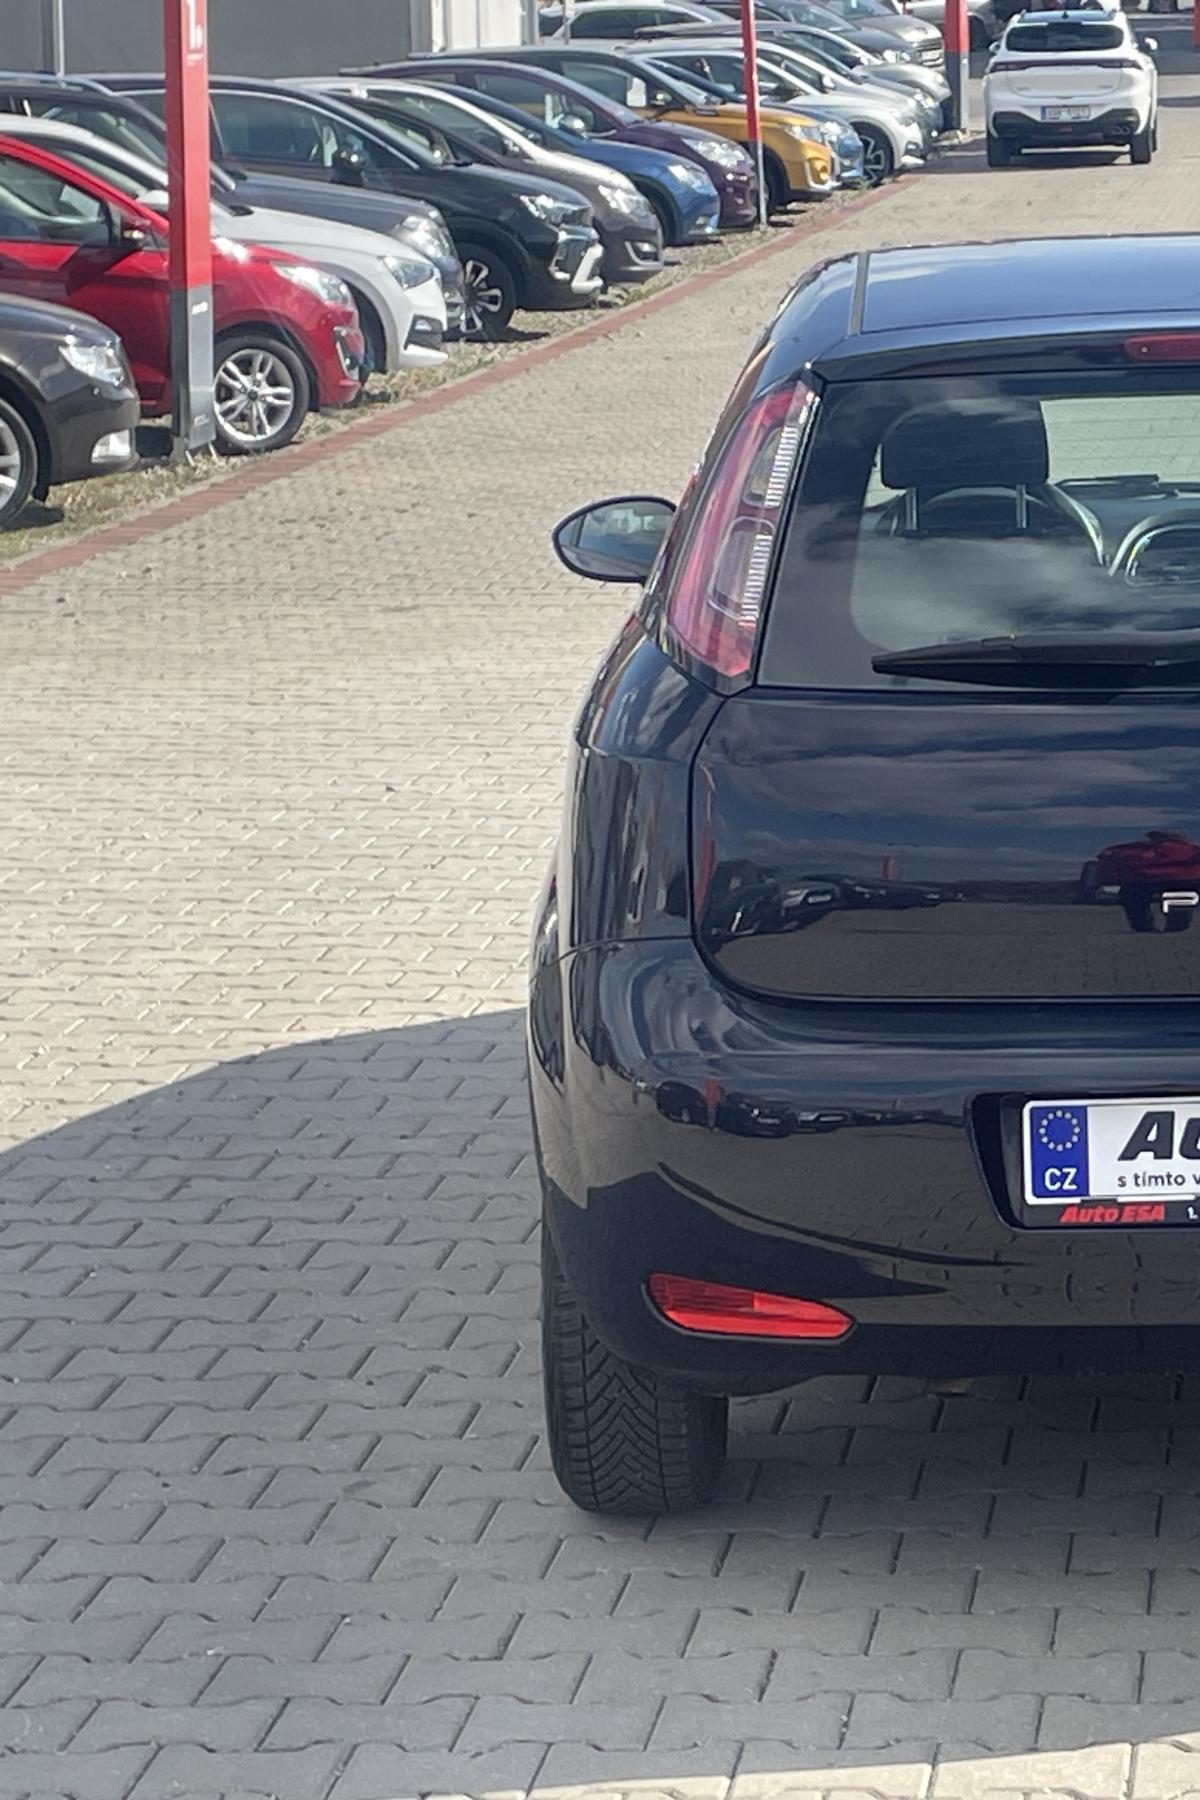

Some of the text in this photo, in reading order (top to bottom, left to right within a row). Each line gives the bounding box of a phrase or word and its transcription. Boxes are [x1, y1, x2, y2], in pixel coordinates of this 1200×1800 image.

[1044, 1167, 1078, 1191] CZ
[1117, 1175, 1127, 1188] s
[1060, 1203, 1166, 1223] Auto ESA
